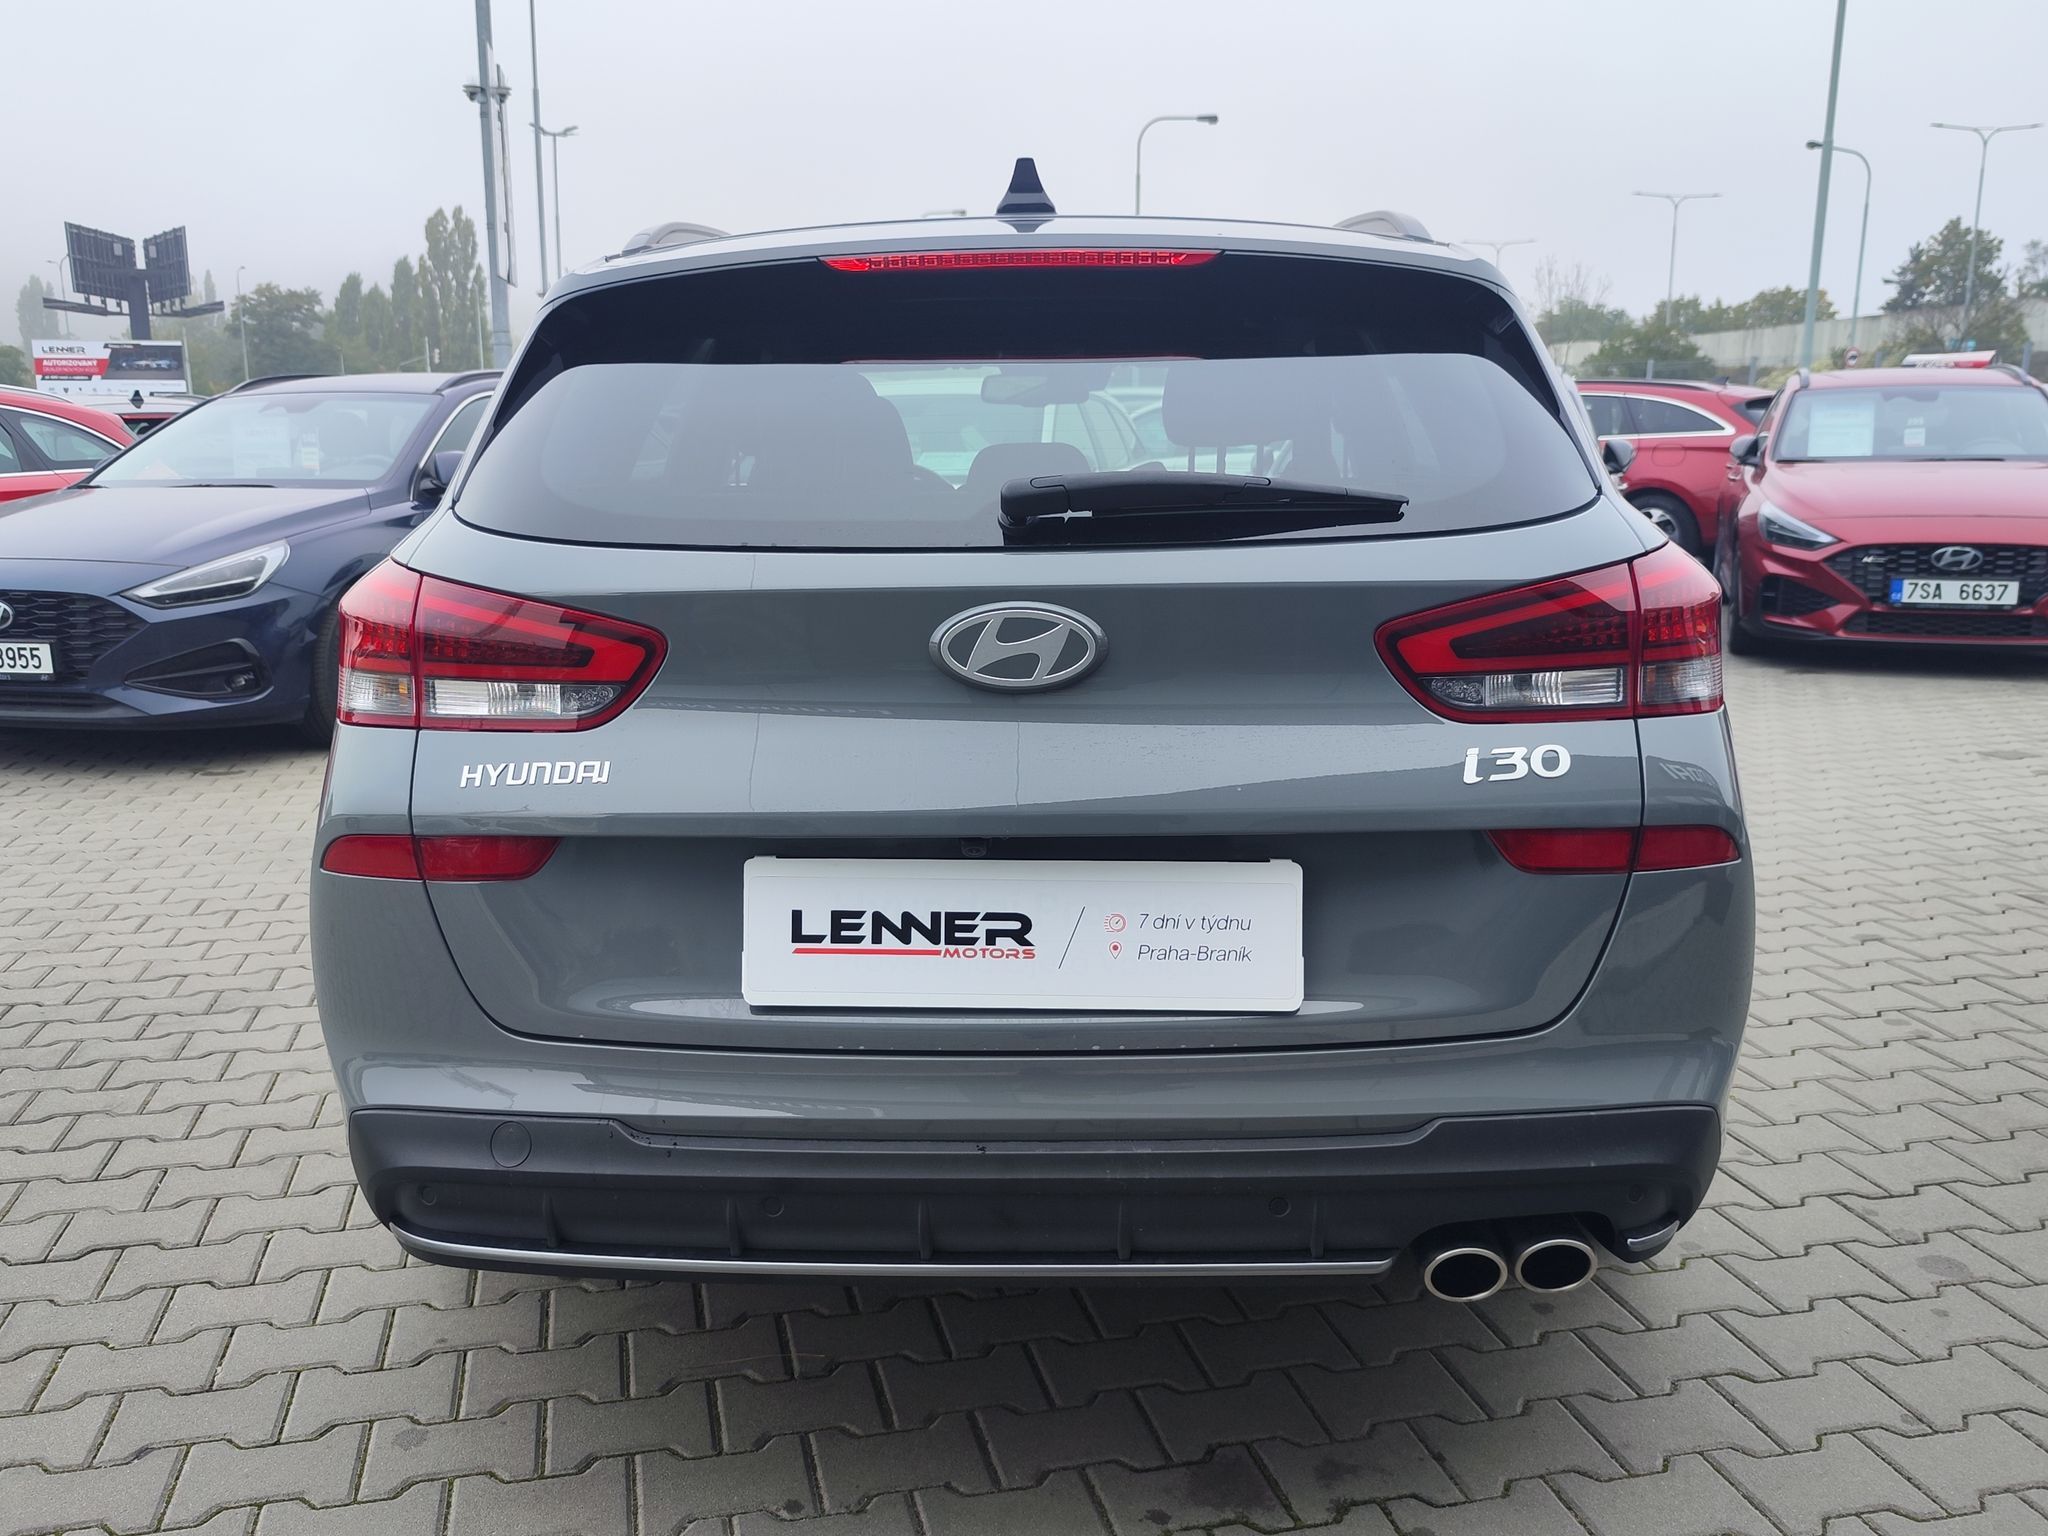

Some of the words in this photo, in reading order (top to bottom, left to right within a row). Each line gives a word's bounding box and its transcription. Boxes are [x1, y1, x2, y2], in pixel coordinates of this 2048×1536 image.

[41, 345, 86, 354] LENNER
[1907, 582, 1942, 600] 7SA
[1959, 583, 2009, 601] 6637
[459, 760, 612, 788] HYUNDAI
[1463, 744, 1571, 784] i30
[791, 909, 1035, 946] LENNER
[1139, 913, 1150, 929] 7
[1152, 913, 1182, 930] dní
[1185, 917, 1196, 930] v
[1201, 915, 1252, 934] týdnu
[943, 947, 1036, 960] MOTORS
[1137, 944, 1252, 962] Praha-Braník
